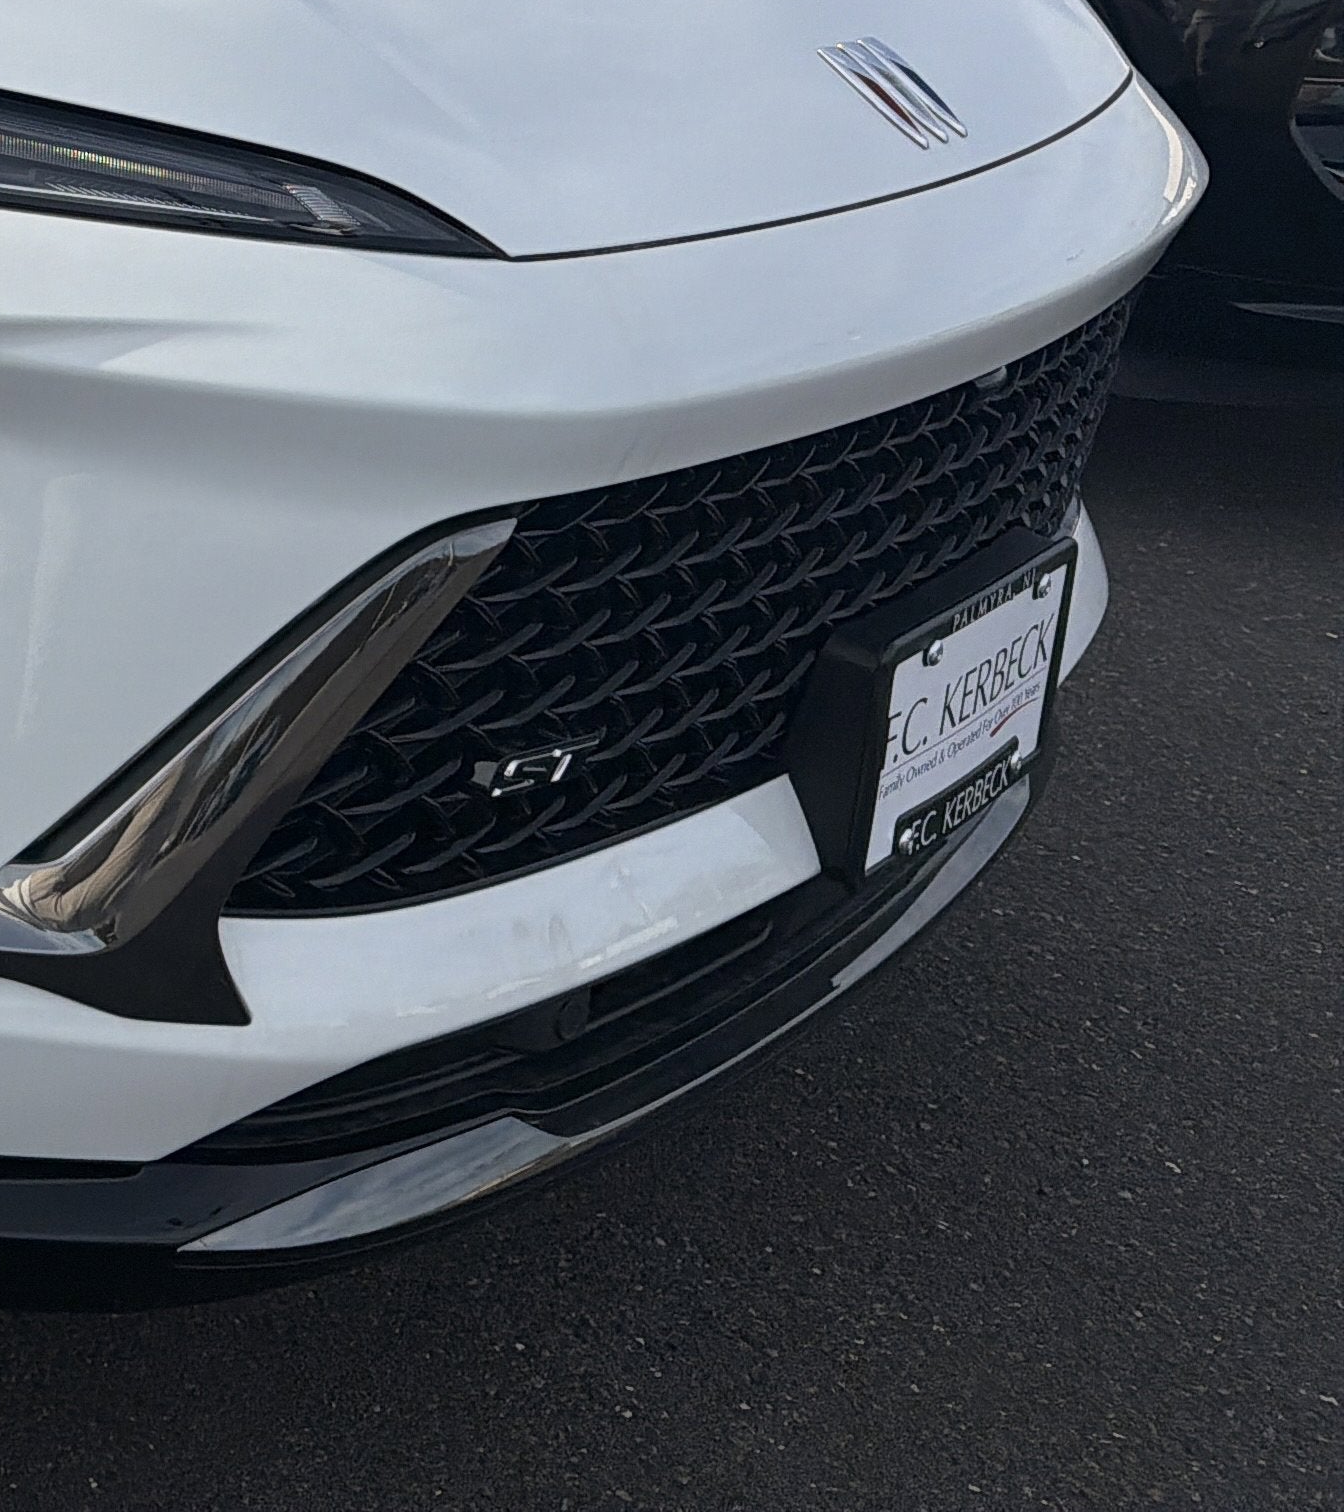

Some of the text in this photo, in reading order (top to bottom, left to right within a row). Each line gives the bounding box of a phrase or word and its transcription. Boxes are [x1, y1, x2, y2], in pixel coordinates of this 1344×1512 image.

[938, 612, 1055, 737] KERBECK
[490, 738, 600, 798] ST
[906, 752, 939, 784] Owned
[941, 755, 1013, 835] KERBECK
